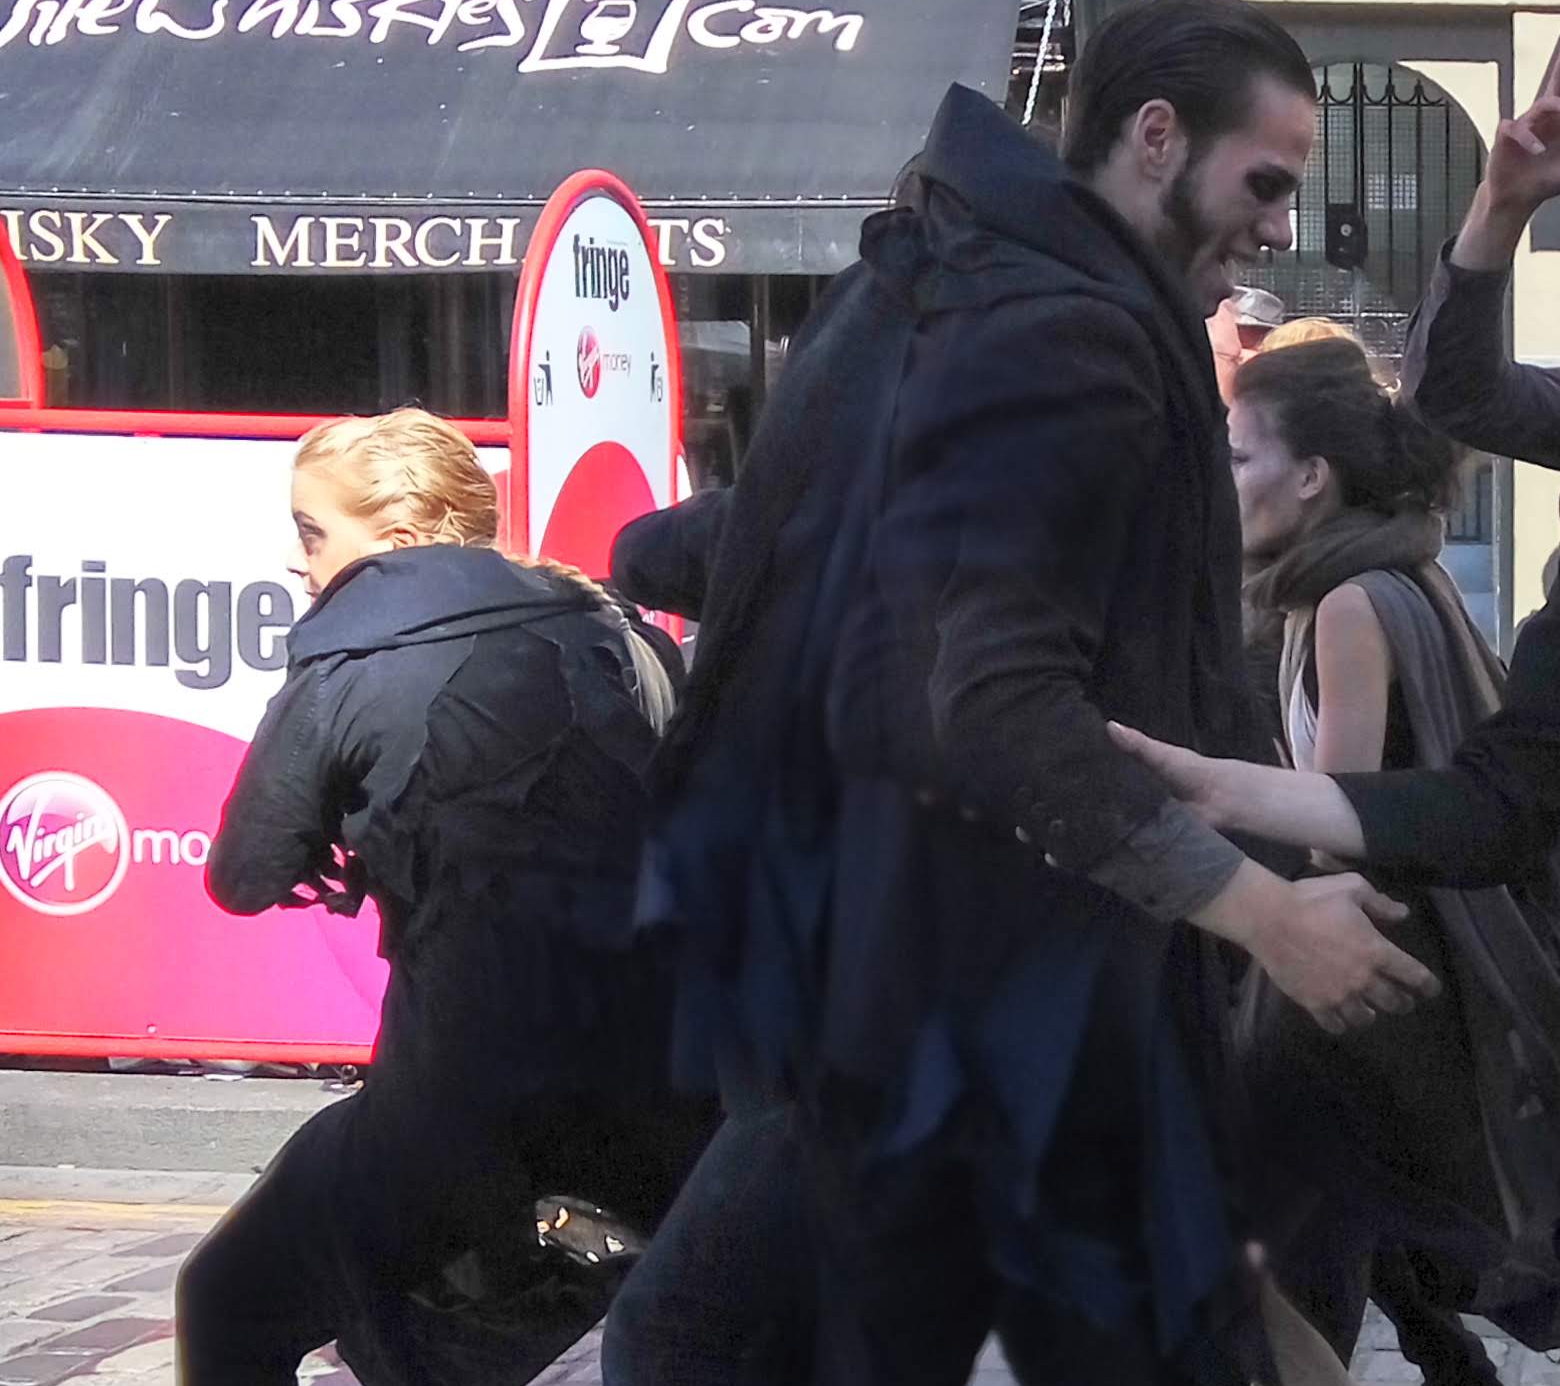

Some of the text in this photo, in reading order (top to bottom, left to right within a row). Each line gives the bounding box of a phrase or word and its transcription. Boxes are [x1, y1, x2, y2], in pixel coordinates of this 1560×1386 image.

[249, 215, 733, 269] MERCHTS
[572, 233, 630, 313] fringe
[0, 554, 295, 690] fringe
[5, 791, 118, 892] Virgin
